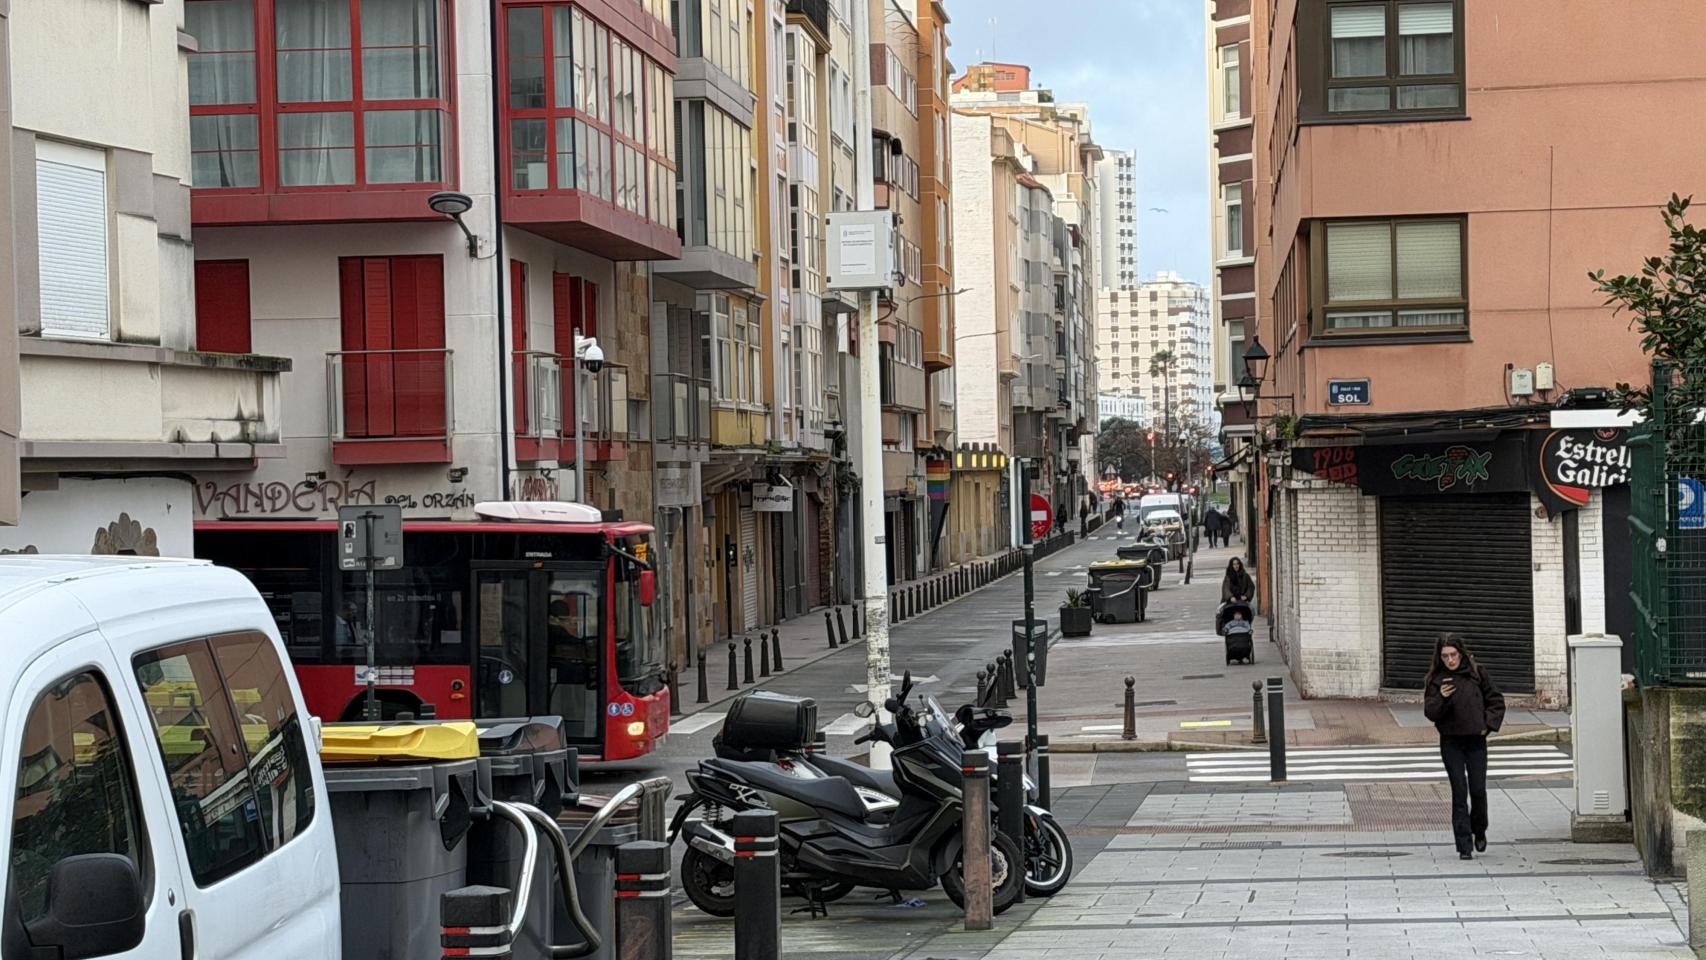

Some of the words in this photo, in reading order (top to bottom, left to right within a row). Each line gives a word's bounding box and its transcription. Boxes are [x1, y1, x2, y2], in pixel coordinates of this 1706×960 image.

[1338, 394, 1361, 403] SOL
[1313, 447, 1355, 469] 1906
[1555, 435, 1632, 469] Estrell
[1557, 459, 1632, 487] Galici
[195, 469, 376, 517] VANDERÍA
[384, 494, 417, 509] DEL
[422, 488, 474, 509] ORZÁN
